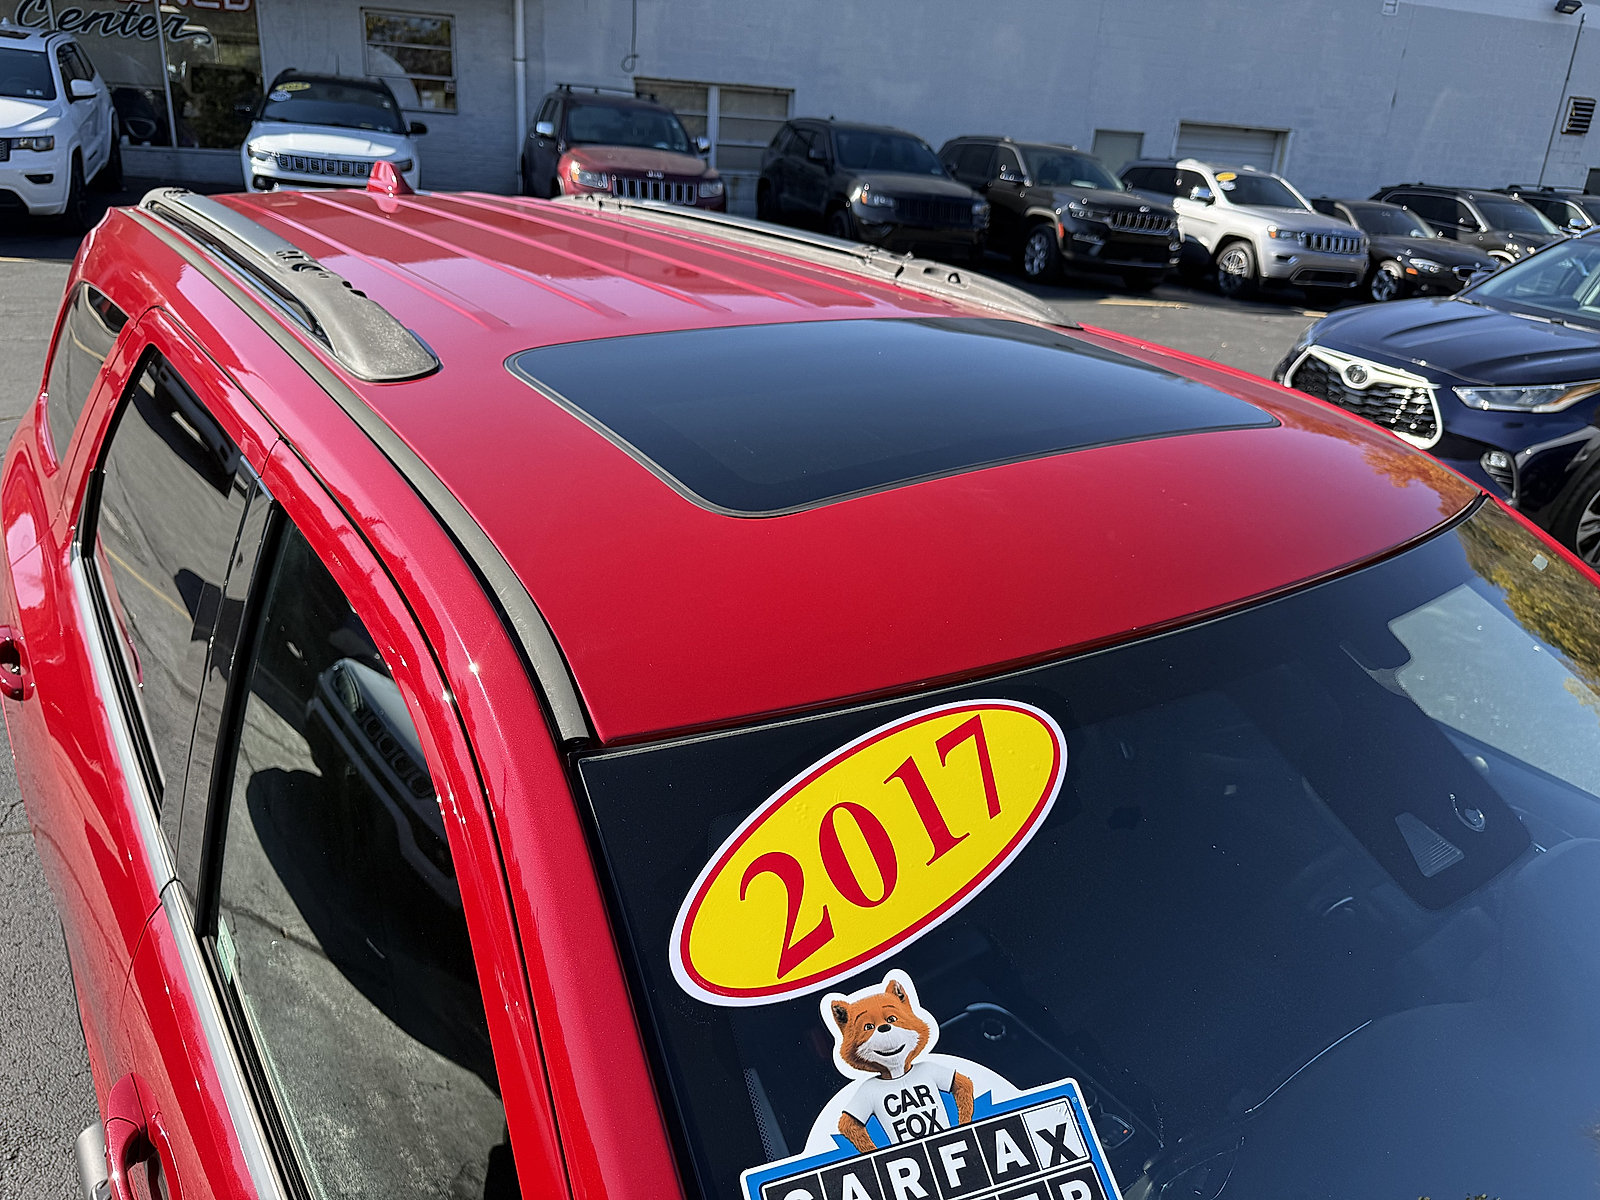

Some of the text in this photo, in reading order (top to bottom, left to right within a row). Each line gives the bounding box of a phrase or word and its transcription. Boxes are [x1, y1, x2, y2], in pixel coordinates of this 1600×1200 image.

[15, 0, 213, 44] Center
[739, 713, 1002, 980] 2017
[883, 1084, 936, 1118] CAR
[892, 1107, 945, 1143] FOX
[783, 1122, 1079, 1200] ARFAX
